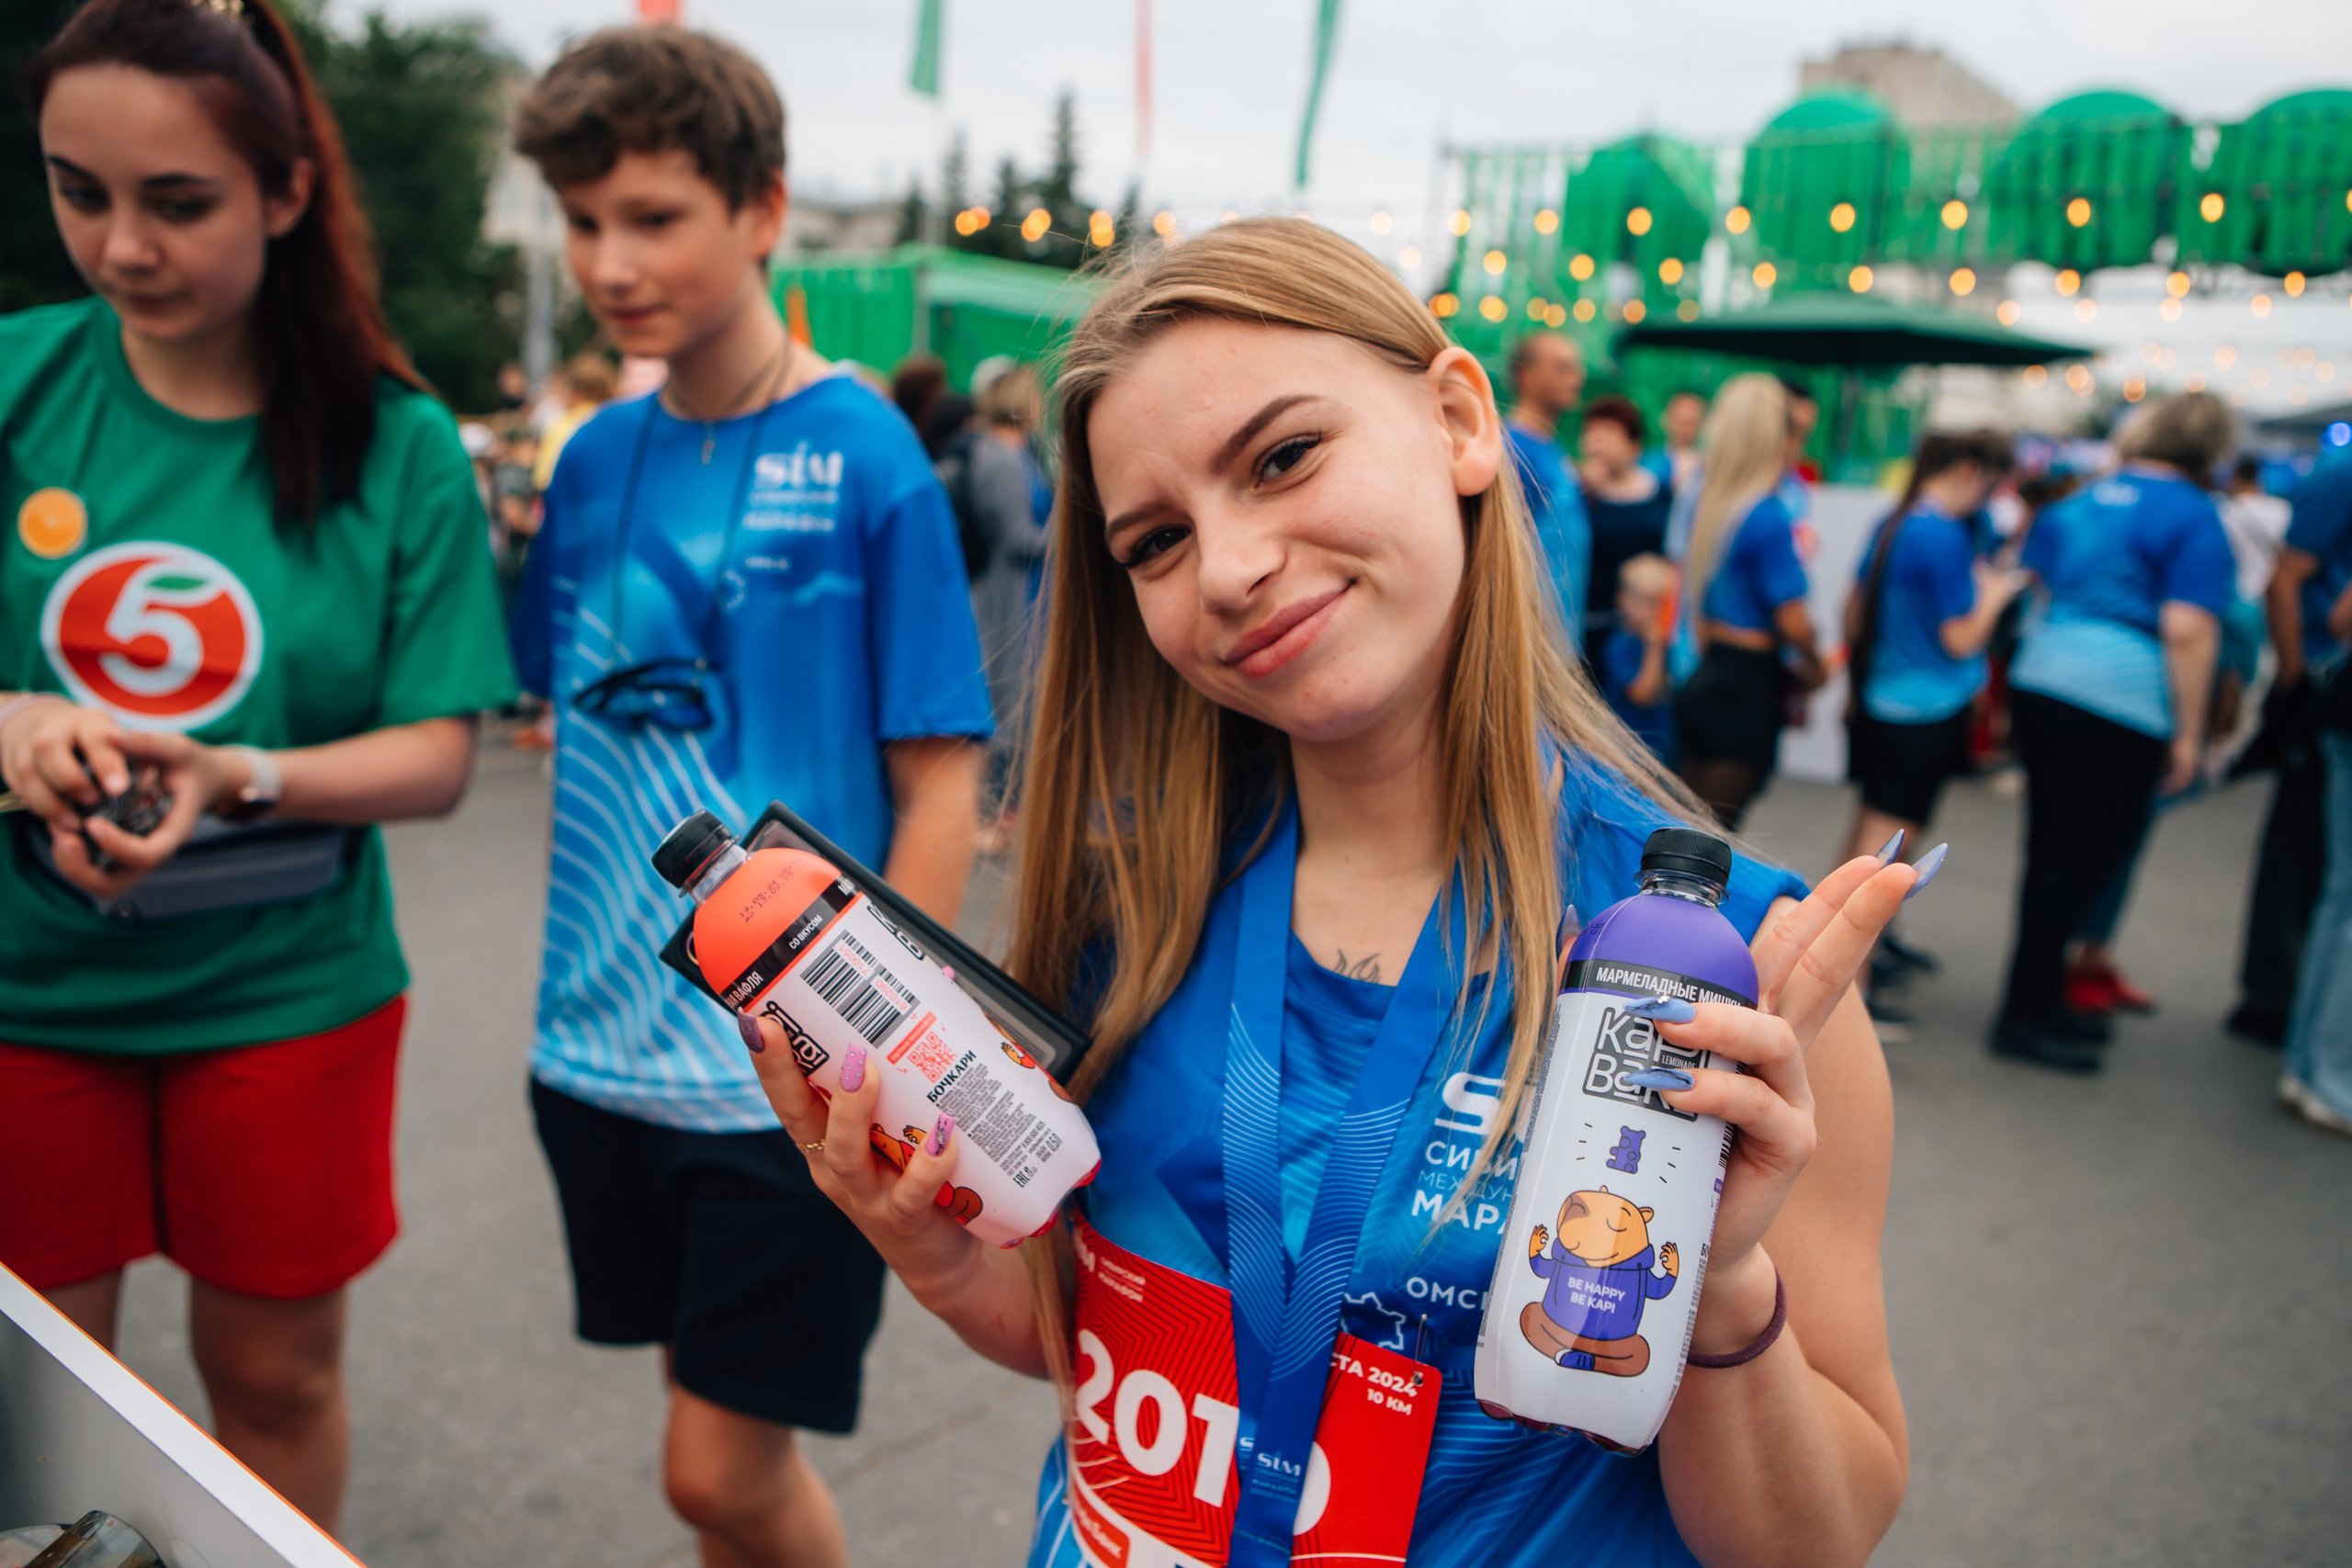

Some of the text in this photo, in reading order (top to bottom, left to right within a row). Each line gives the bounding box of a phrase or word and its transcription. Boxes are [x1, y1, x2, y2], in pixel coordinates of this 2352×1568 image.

[98, 557, 222, 697] 5
[788, 915, 823, 950] СО ВКУСОМ
[731, 970, 763, 1001] ВАФЛЯ
[1596, 966, 1698, 1001] МАРМЕЛАДНЫЕ
[925, 1048, 978, 1103] БОЧКАРИ
[1661, 1055, 1696, 1068] LEMONADE
[1411, 1190, 1508, 1235] МАР
[1568, 1277, 1625, 1302] BE HAPPY
[1570, 1292, 1616, 1314] BE KAPI
[1367, 1367, 1418, 1397] 2024
[1367, 1388, 1412, 1416] 10 КМ
[1257, 1452, 1301, 1476] SIM
